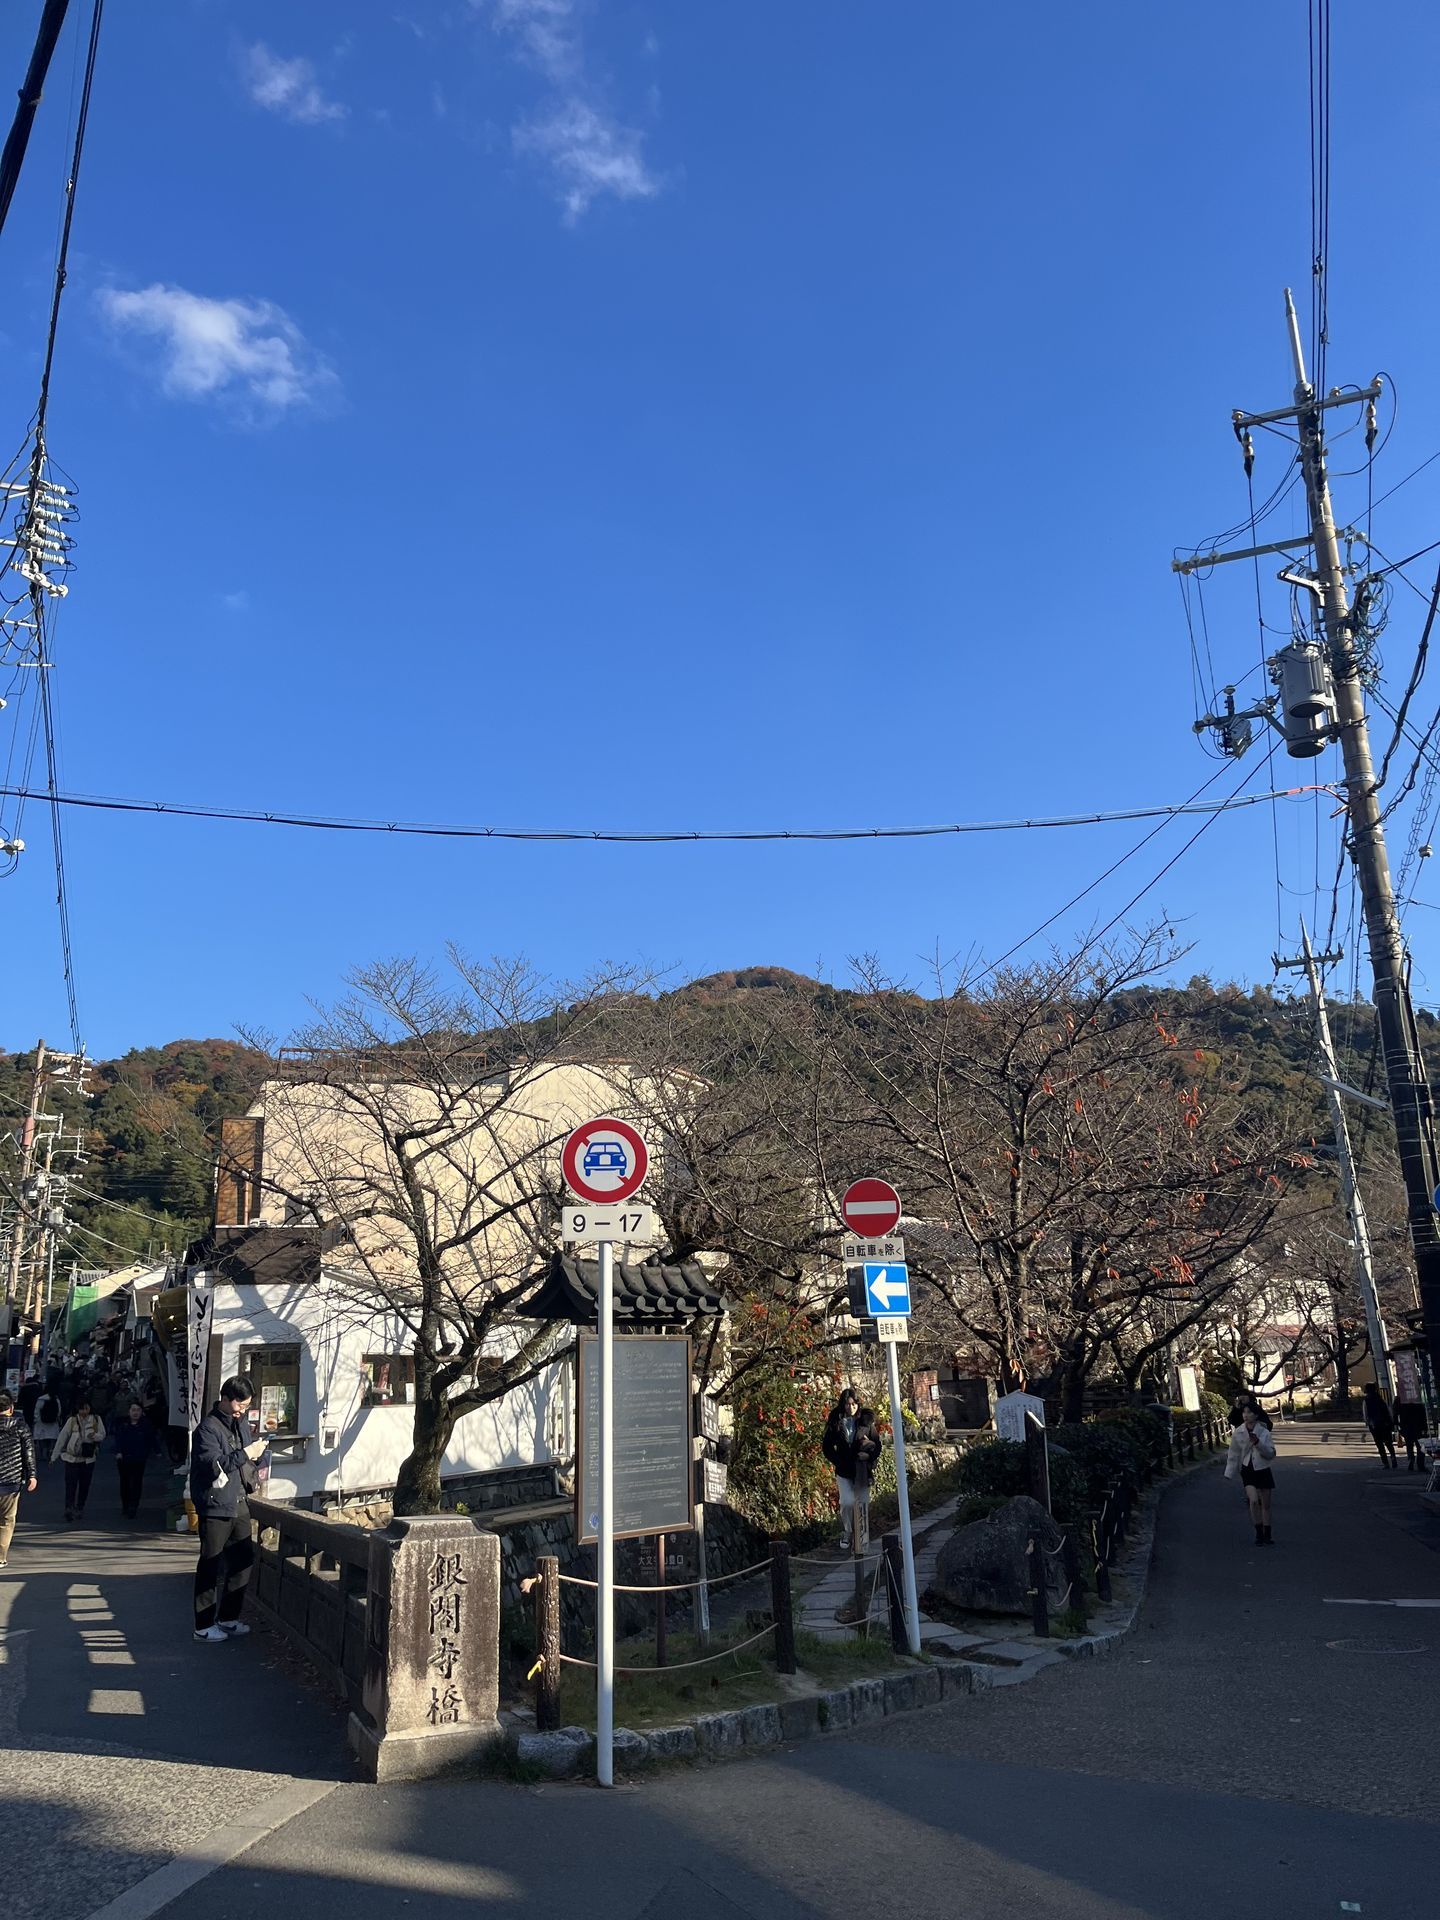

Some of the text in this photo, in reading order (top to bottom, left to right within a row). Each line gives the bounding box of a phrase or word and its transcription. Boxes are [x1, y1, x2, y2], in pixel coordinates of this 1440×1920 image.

[846, 1243, 902, 1257] 自転車を除く
[427, 1553, 468, 1724] 銀閣寺橋
